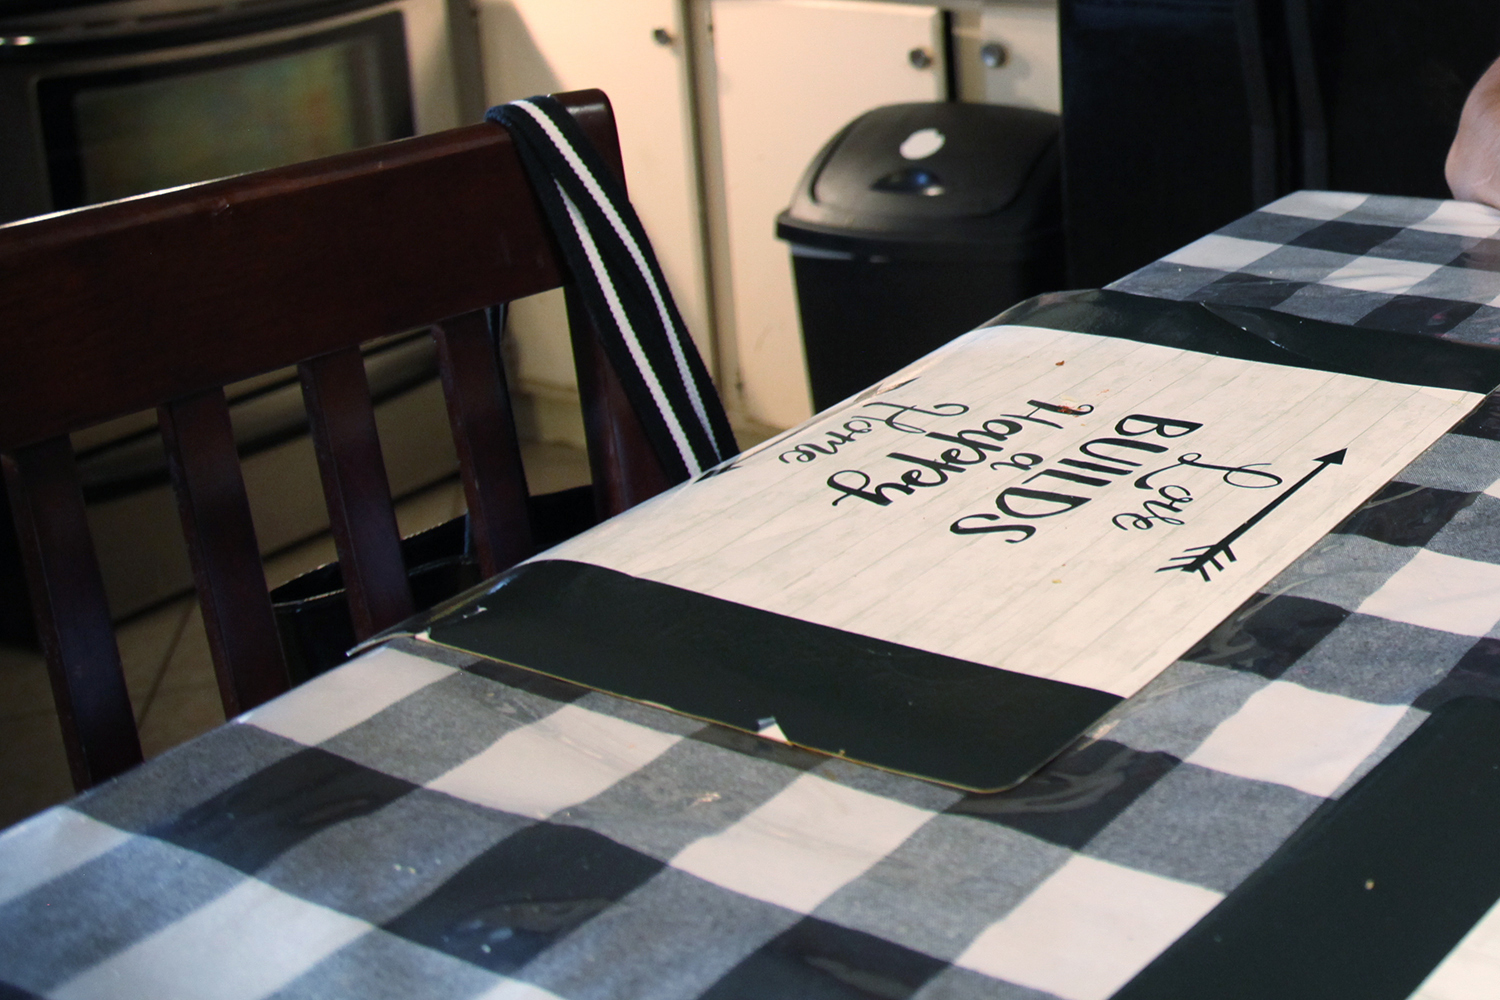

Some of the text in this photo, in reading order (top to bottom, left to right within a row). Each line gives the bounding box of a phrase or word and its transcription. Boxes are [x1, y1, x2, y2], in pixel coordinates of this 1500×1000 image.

[778, 401, 970, 465] Home
[826, 399, 1095, 507] Happy
[989, 452, 1044, 472] a
[949, 414, 1204, 544] BUILDS
[1111, 453, 1283, 531] Love
